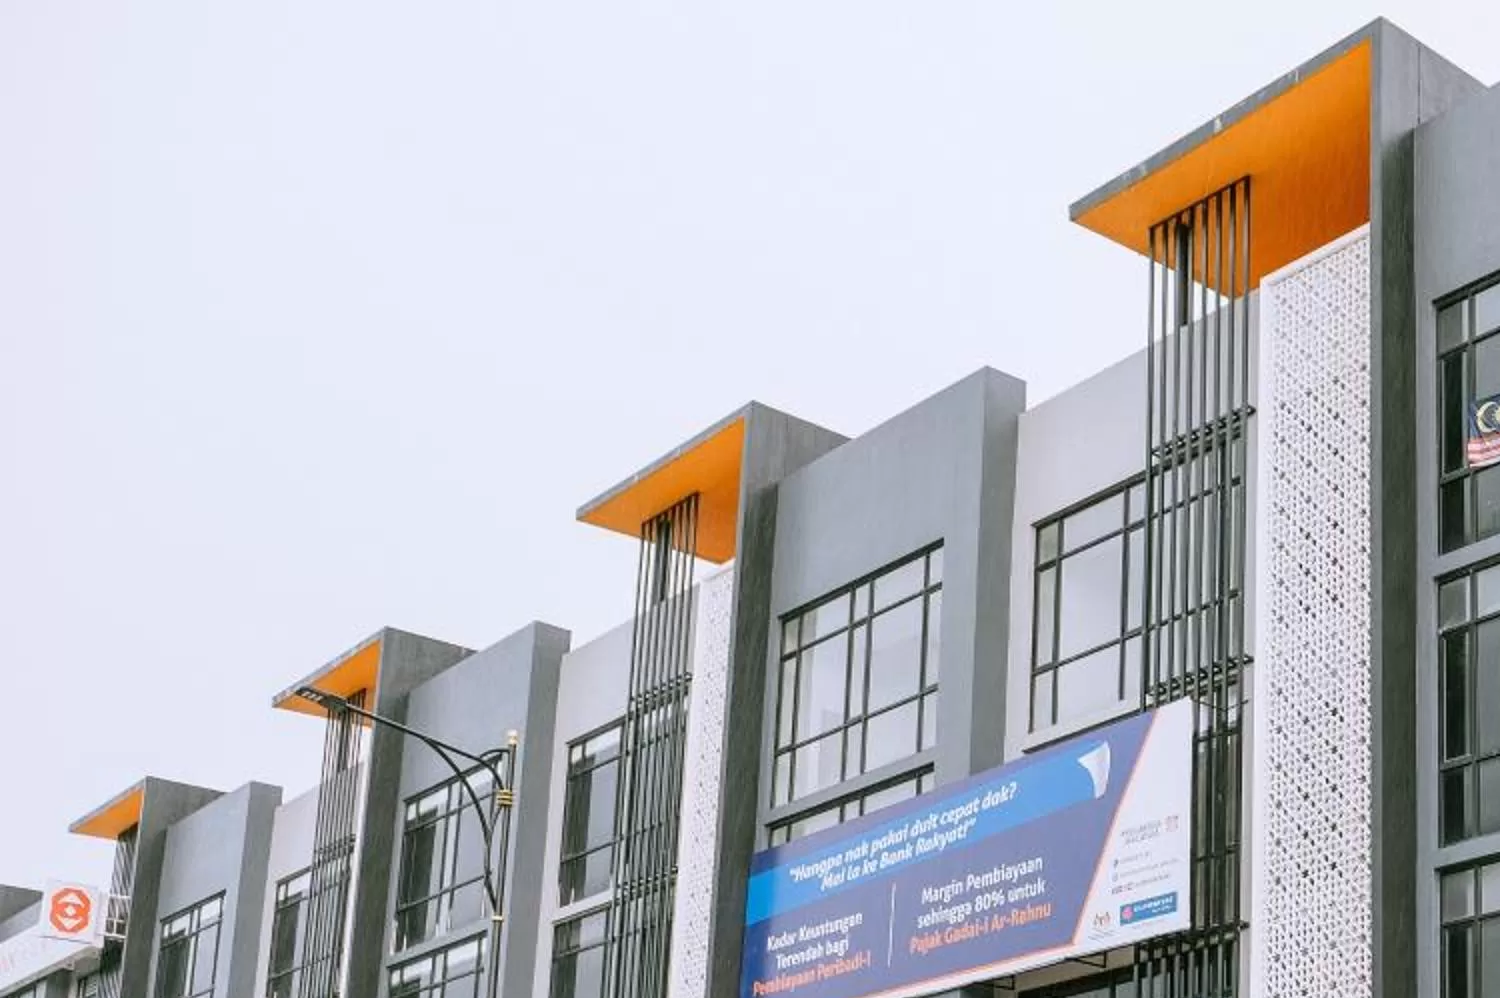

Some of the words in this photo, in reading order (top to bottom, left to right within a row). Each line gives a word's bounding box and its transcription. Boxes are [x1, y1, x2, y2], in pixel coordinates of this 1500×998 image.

[880, 843, 914, 869] Bank
[920, 879, 964, 905] Margin
[965, 855, 1044, 892] Pembiayaan
[917, 902, 972, 929] sehingga
[974, 888, 1006, 913] 80%
[1007, 877, 1047, 903] untuk
